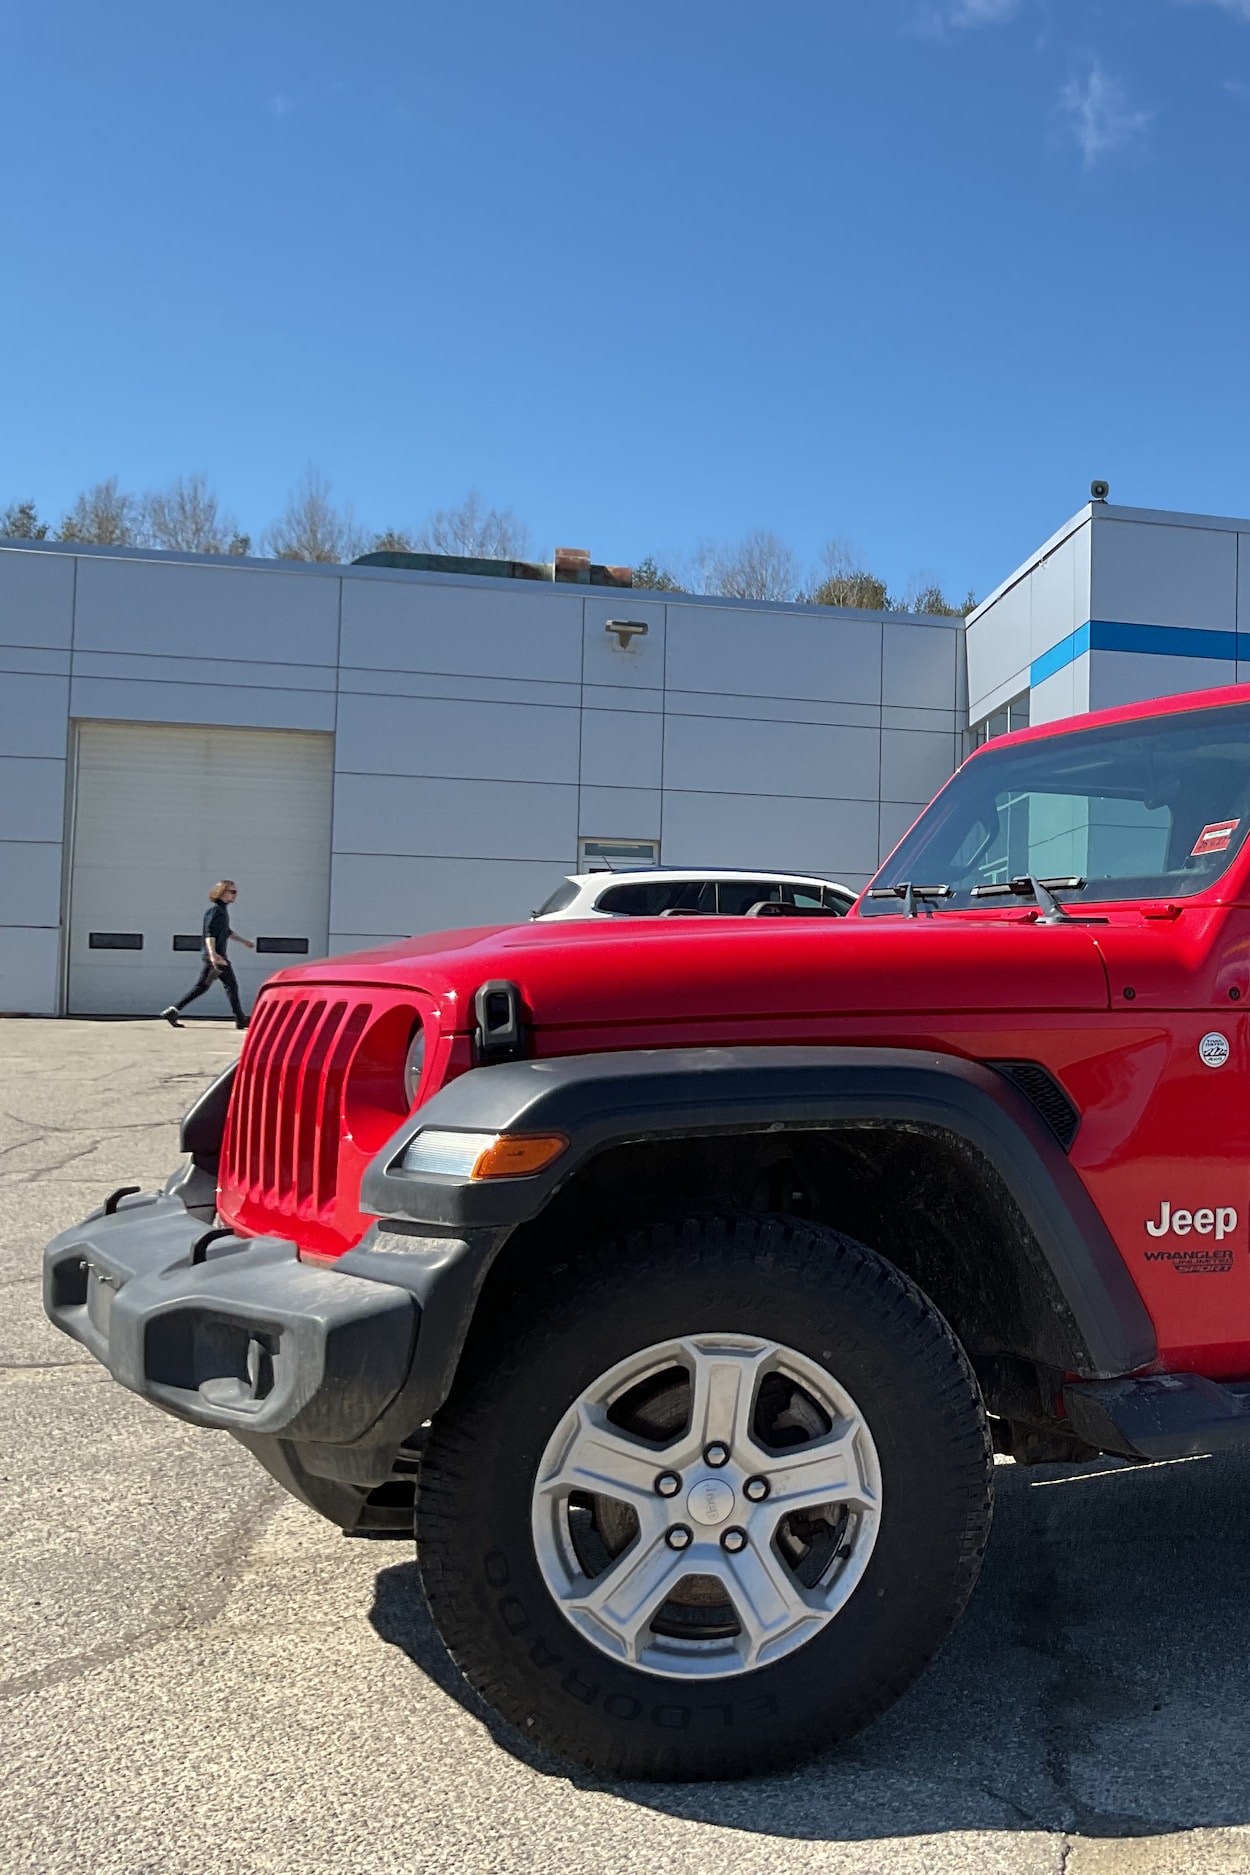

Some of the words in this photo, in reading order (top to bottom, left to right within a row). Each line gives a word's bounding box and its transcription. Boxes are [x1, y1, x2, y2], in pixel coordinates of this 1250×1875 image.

[1145, 1201, 1238, 1241] Jeep
[1143, 1249, 1234, 1261] WRANGLER
[1176, 1264, 1232, 1273] SPORT
[483, 1548, 780, 1730] ELDORADO
